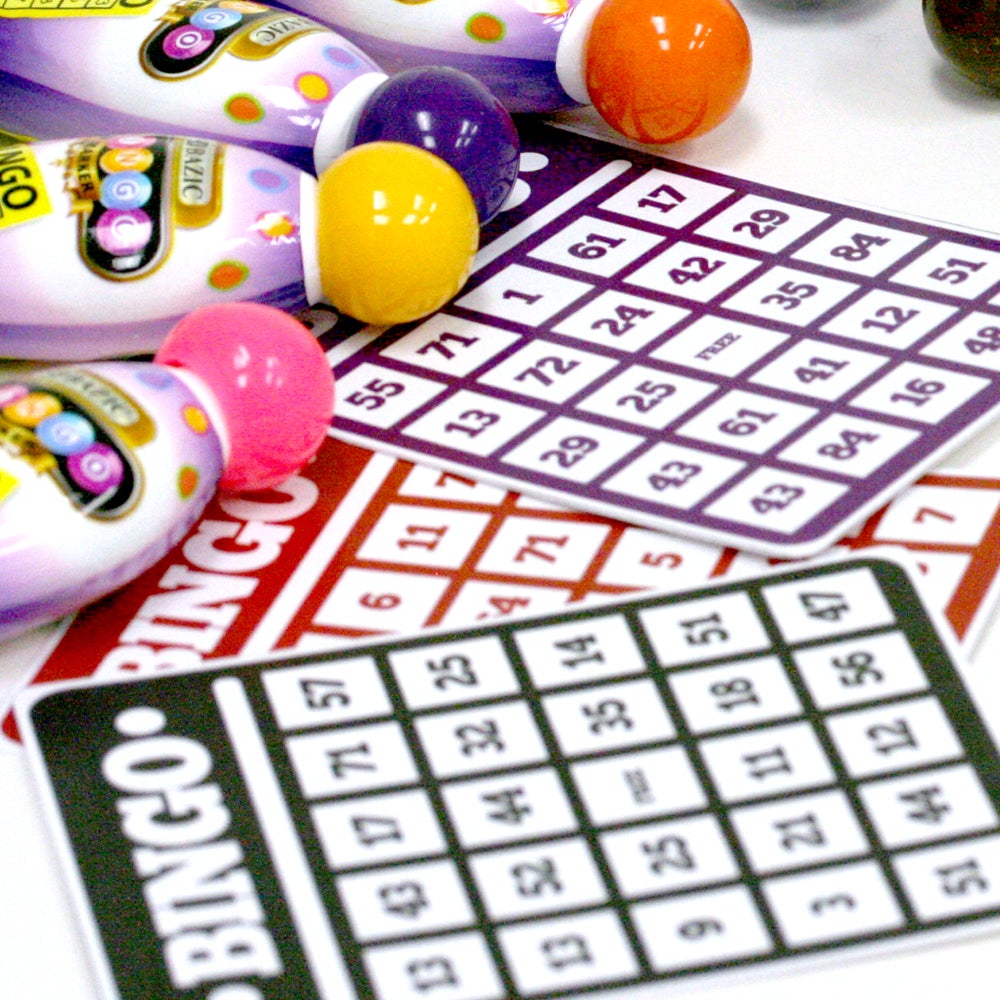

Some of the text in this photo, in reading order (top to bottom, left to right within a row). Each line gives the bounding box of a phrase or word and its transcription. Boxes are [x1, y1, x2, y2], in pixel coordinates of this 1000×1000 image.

[344, 184, 687, 410] 55 71 1 61 17
[445, 209, 790, 438] 13 72 24 42 29
[540, 233, 890, 468] 29 25 FREE 35 84
[648, 258, 986, 491] 43 61 41 12 51
[514, 536, 569, 563] 71
[641, 553, 683, 568] 5
[751, 484, 804, 514] 43
[818, 430, 879, 460] 84
[891, 379, 945, 406] 16
[359, 525, 448, 610] 6 11
[298, 678, 459, 993] 13 43 17 71 57
[426, 654, 593, 971] 13 52 44 32 25
[554, 634, 723, 940] 9 25 35 14
[679, 612, 856, 914] 3 21 11 18 51
[798, 592, 988, 896] 51 44 12 56 47
[101, 735, 285, 989] BINGO
